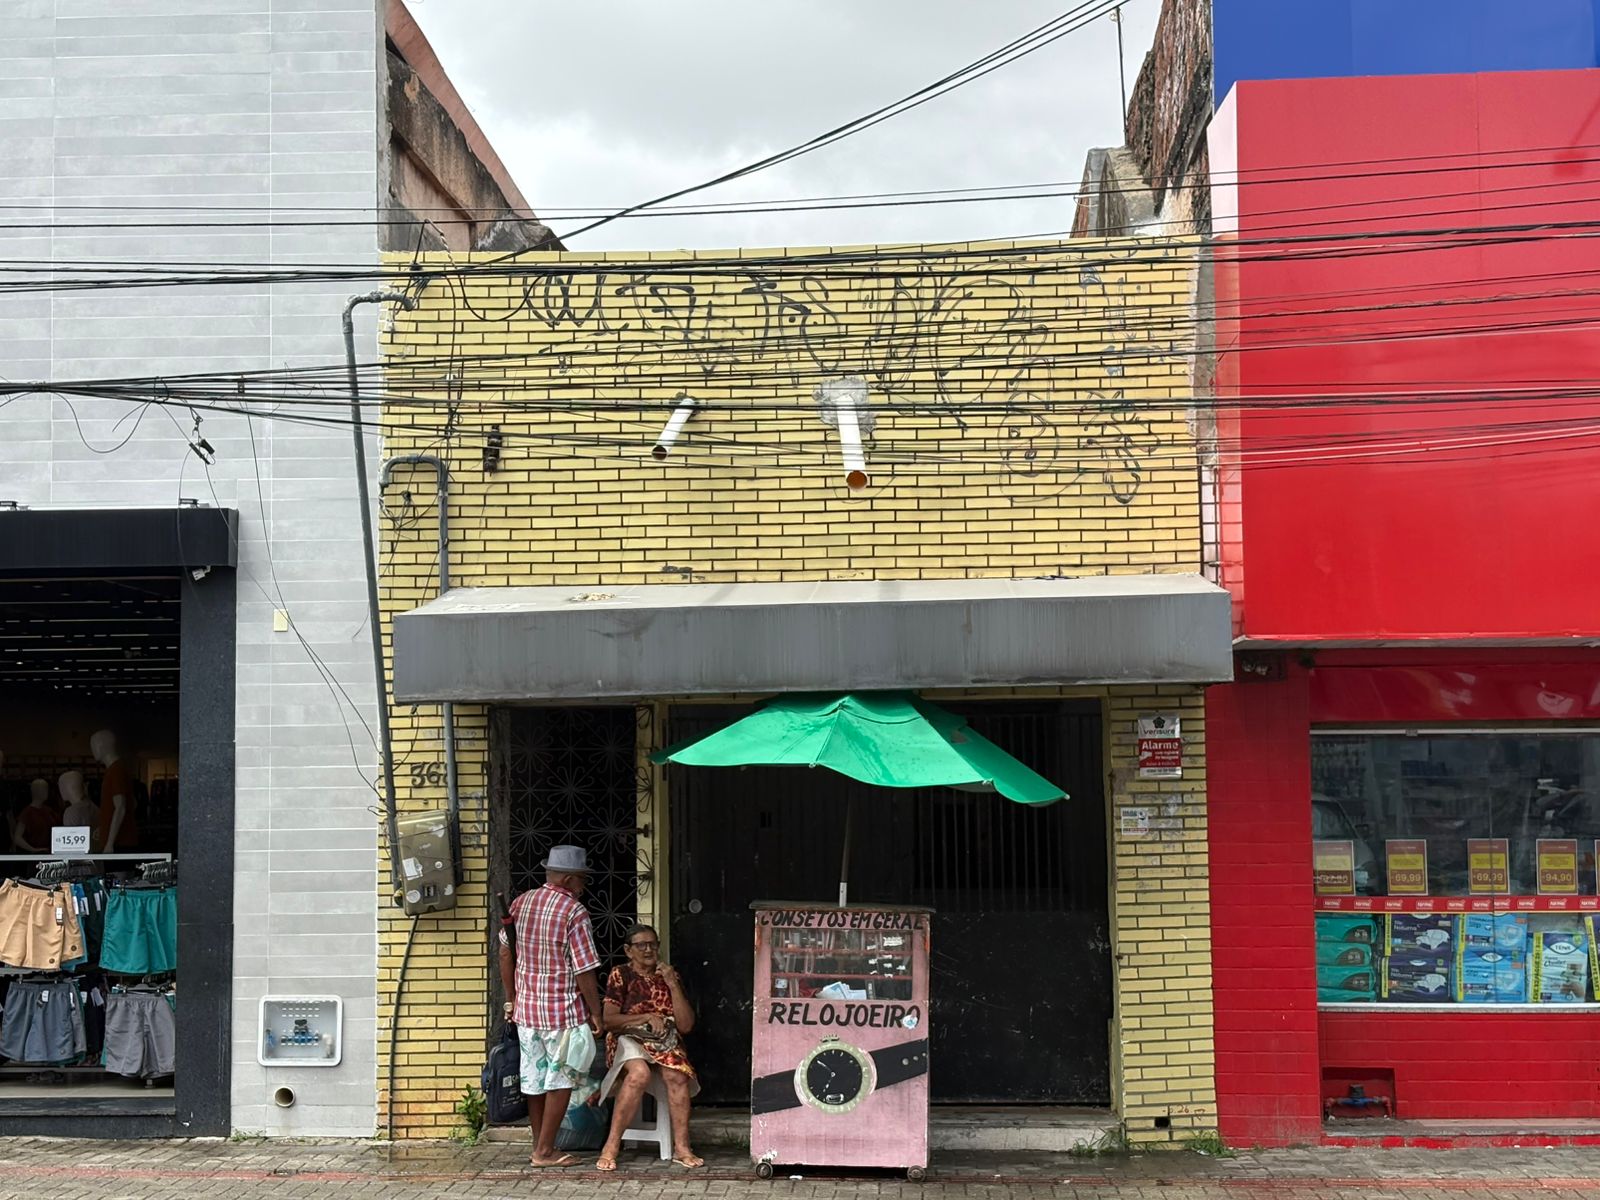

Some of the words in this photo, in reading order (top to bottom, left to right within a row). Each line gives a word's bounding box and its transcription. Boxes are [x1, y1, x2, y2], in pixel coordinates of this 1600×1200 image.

[1142, 741, 1179, 750] Alarme
[62, 836, 86, 845] 15,99
[761, 911, 848, 927] CONSETOS
[850, 912, 871, 929] EM
[768, 1002, 921, 1028] RELOJOEIRO
